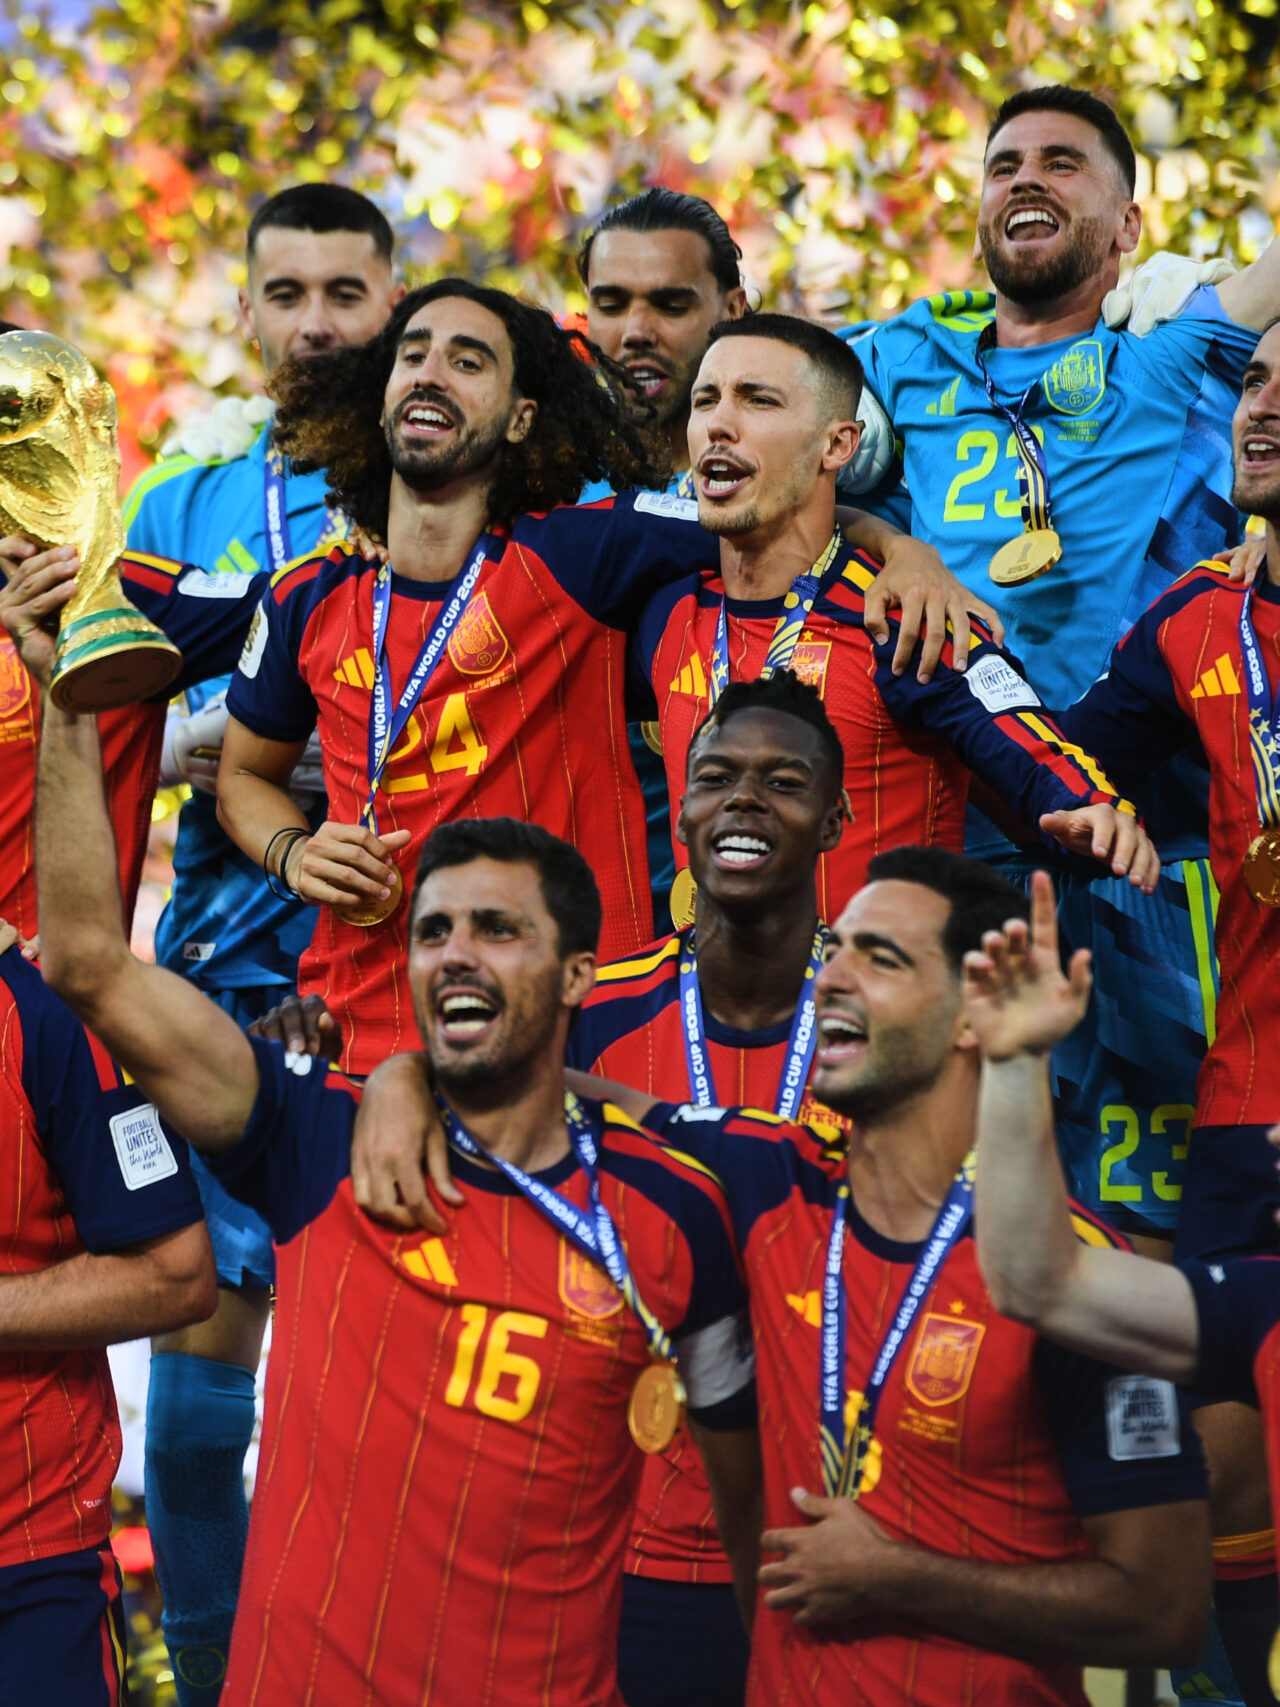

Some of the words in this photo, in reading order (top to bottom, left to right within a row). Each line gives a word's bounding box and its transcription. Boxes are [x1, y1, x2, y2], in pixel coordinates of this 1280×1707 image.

[398, 678, 422, 709] FIFA
[415, 627, 447, 679] WORLD
[441, 600, 461, 628] CUP
[457, 551, 486, 600] 2026
[1240, 620, 1253, 647] CUP
[1246, 647, 1264, 696] 2026
[374, 685, 387, 738] WORLD
[379, 692, 487, 795] 24
[685, 987, 700, 1043] 2026
[793, 1000, 816, 1056] 2026
[690, 1043, 705, 1075] CUP
[786, 1054, 804, 1088] CUP
[125, 1128, 158, 1152] UNITES
[1099, 1104, 1196, 1202] 23
[936, 1203, 965, 1241] FIFA
[824, 1274, 839, 1311] CUP
[910, 1238, 948, 1298] WORLD
[895, 1295, 920, 1331] CUP
[444, 1303, 548, 1423] 16
[823, 1311, 839, 1374] WORLD
[870, 1328, 904, 1387] 2026
[823, 1374, 839, 1412] FIFA
